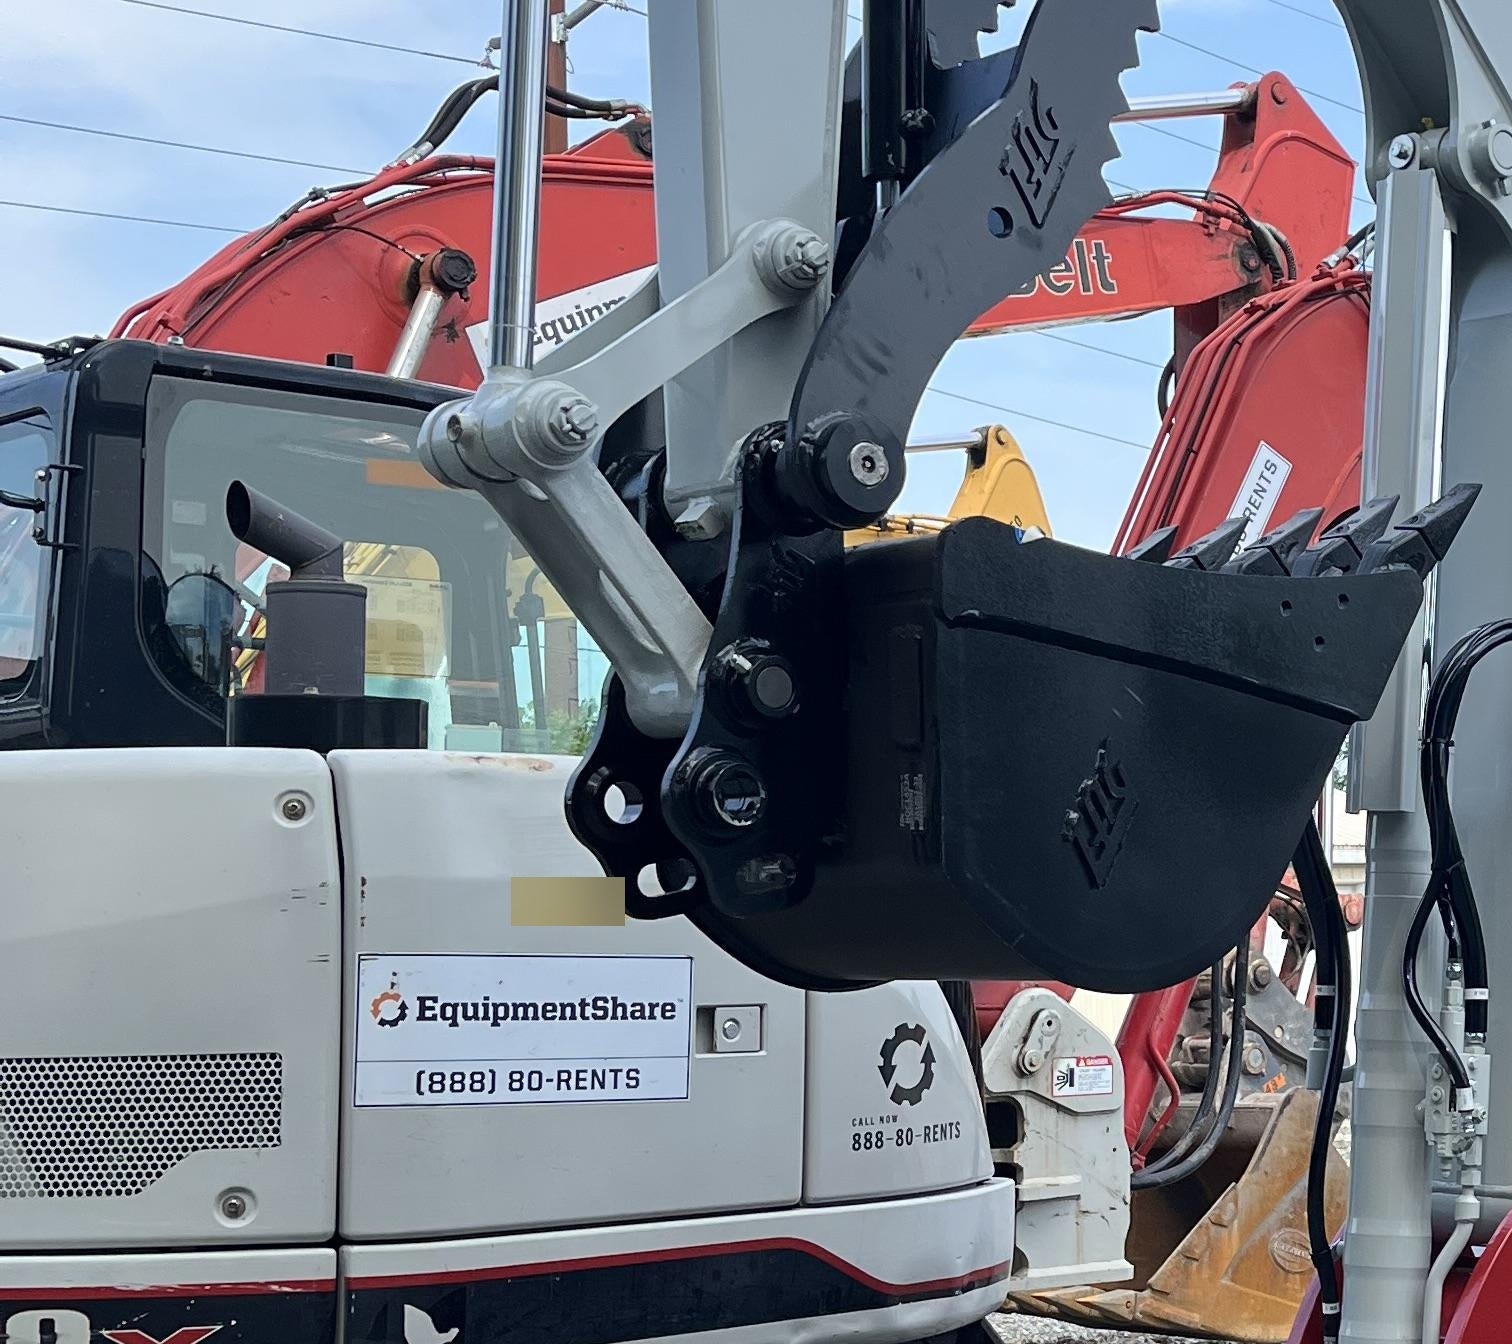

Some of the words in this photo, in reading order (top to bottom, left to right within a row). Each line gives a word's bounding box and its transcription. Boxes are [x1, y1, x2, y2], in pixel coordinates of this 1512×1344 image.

[416, 996, 677, 1027] EquipmentShare
[415, 1070, 497, 1096] (888)
[508, 1068, 641, 1092] 80-RENTS
[851, 1117, 875, 1127] CALL
[879, 1114, 899, 1124] NOW
[851, 1120, 962, 1152] 888-80-RENTS
